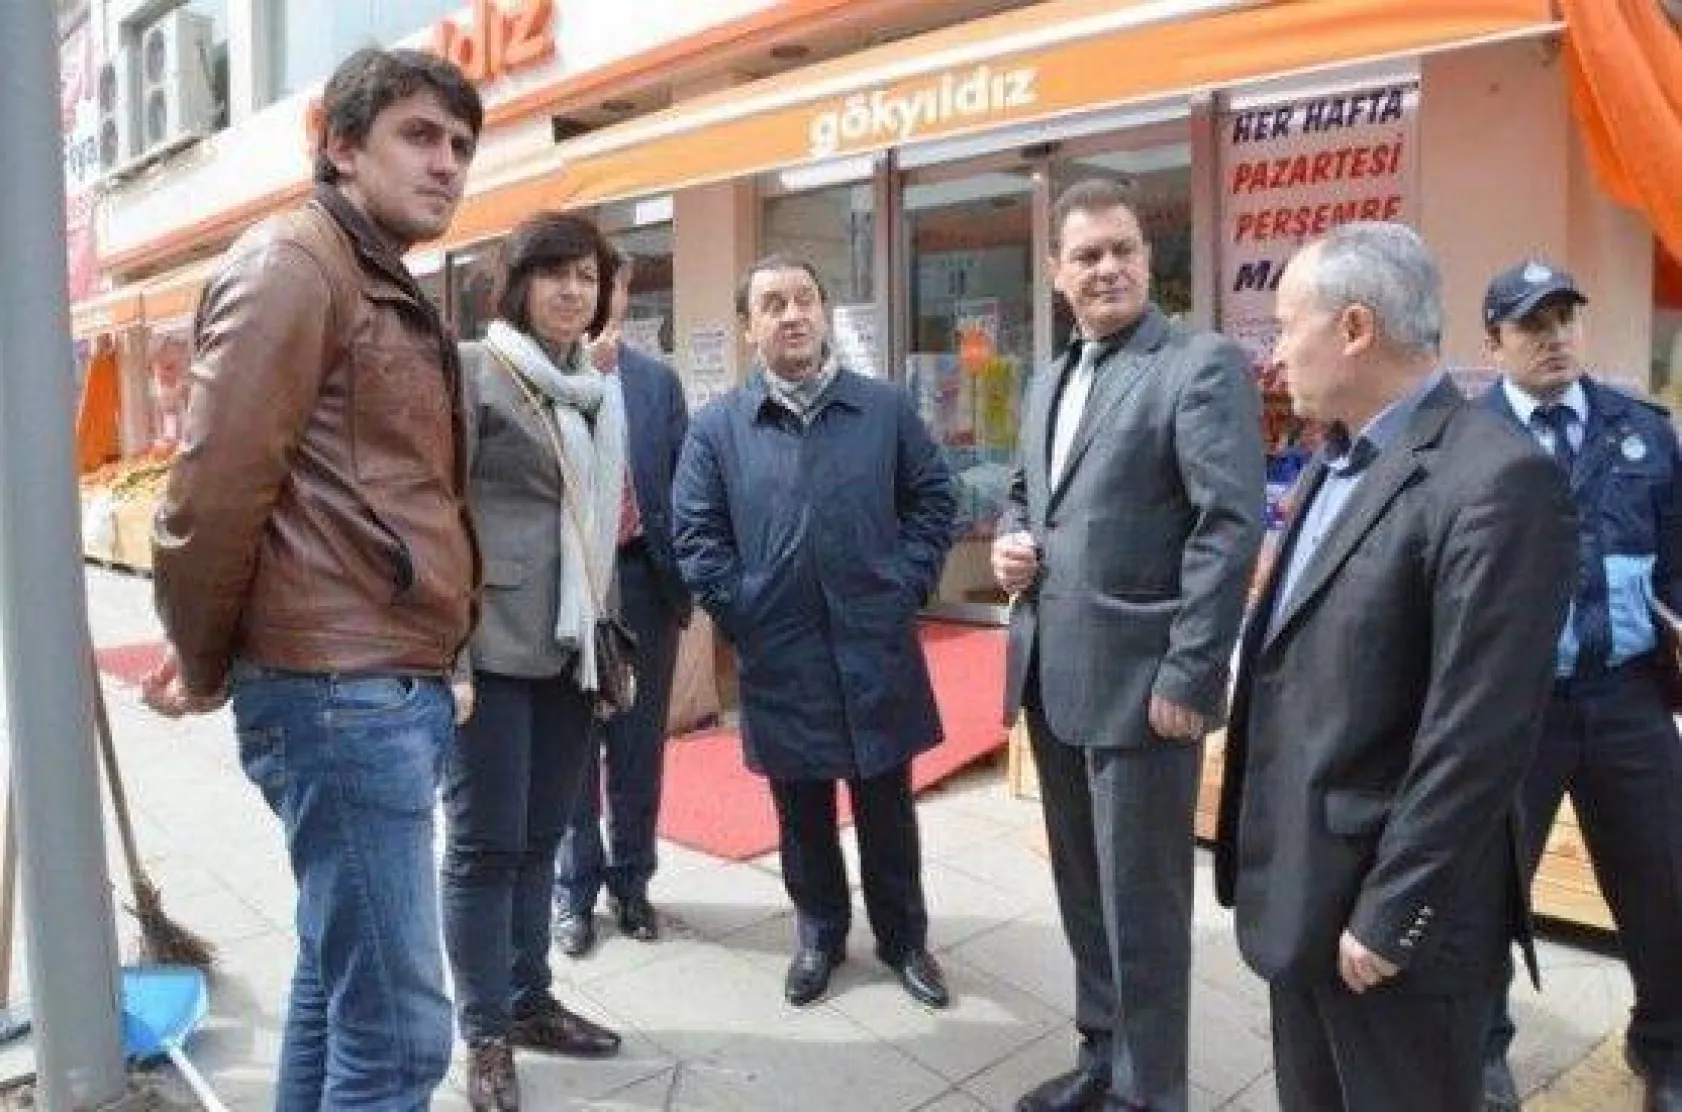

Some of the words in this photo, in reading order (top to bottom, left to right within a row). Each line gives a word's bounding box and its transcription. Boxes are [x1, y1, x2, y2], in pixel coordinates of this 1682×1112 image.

[808, 65, 1039, 158] gökyıldız
[1233, 106, 1294, 145] HER
[1303, 87, 1404, 134] HAFTA
[1233, 133, 1404, 194] PAZARTESİ
